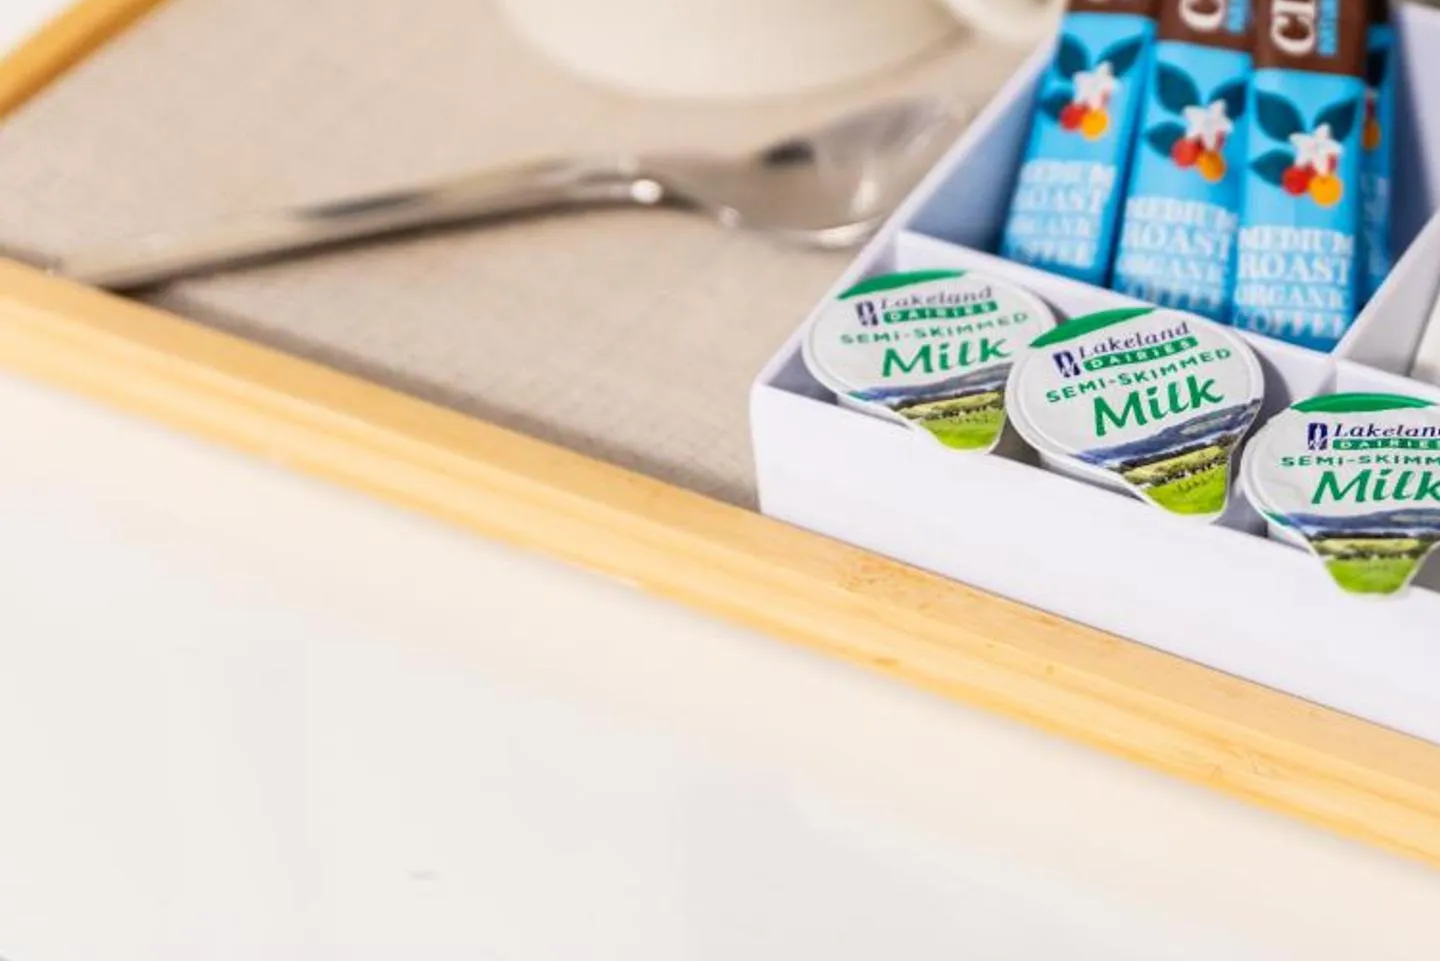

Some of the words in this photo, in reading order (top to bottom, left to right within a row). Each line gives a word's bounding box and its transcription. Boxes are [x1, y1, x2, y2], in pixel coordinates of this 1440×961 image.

[880, 285, 993, 310] Lakeland
[882, 338, 1012, 377] Milk
[1079, 321, 1190, 359] Lakeland
[1088, 338, 1196, 370] DAIRIES
[1045, 348, 1232, 403] SEMI-SKIMMED
[1093, 375, 1225, 437] Milk
